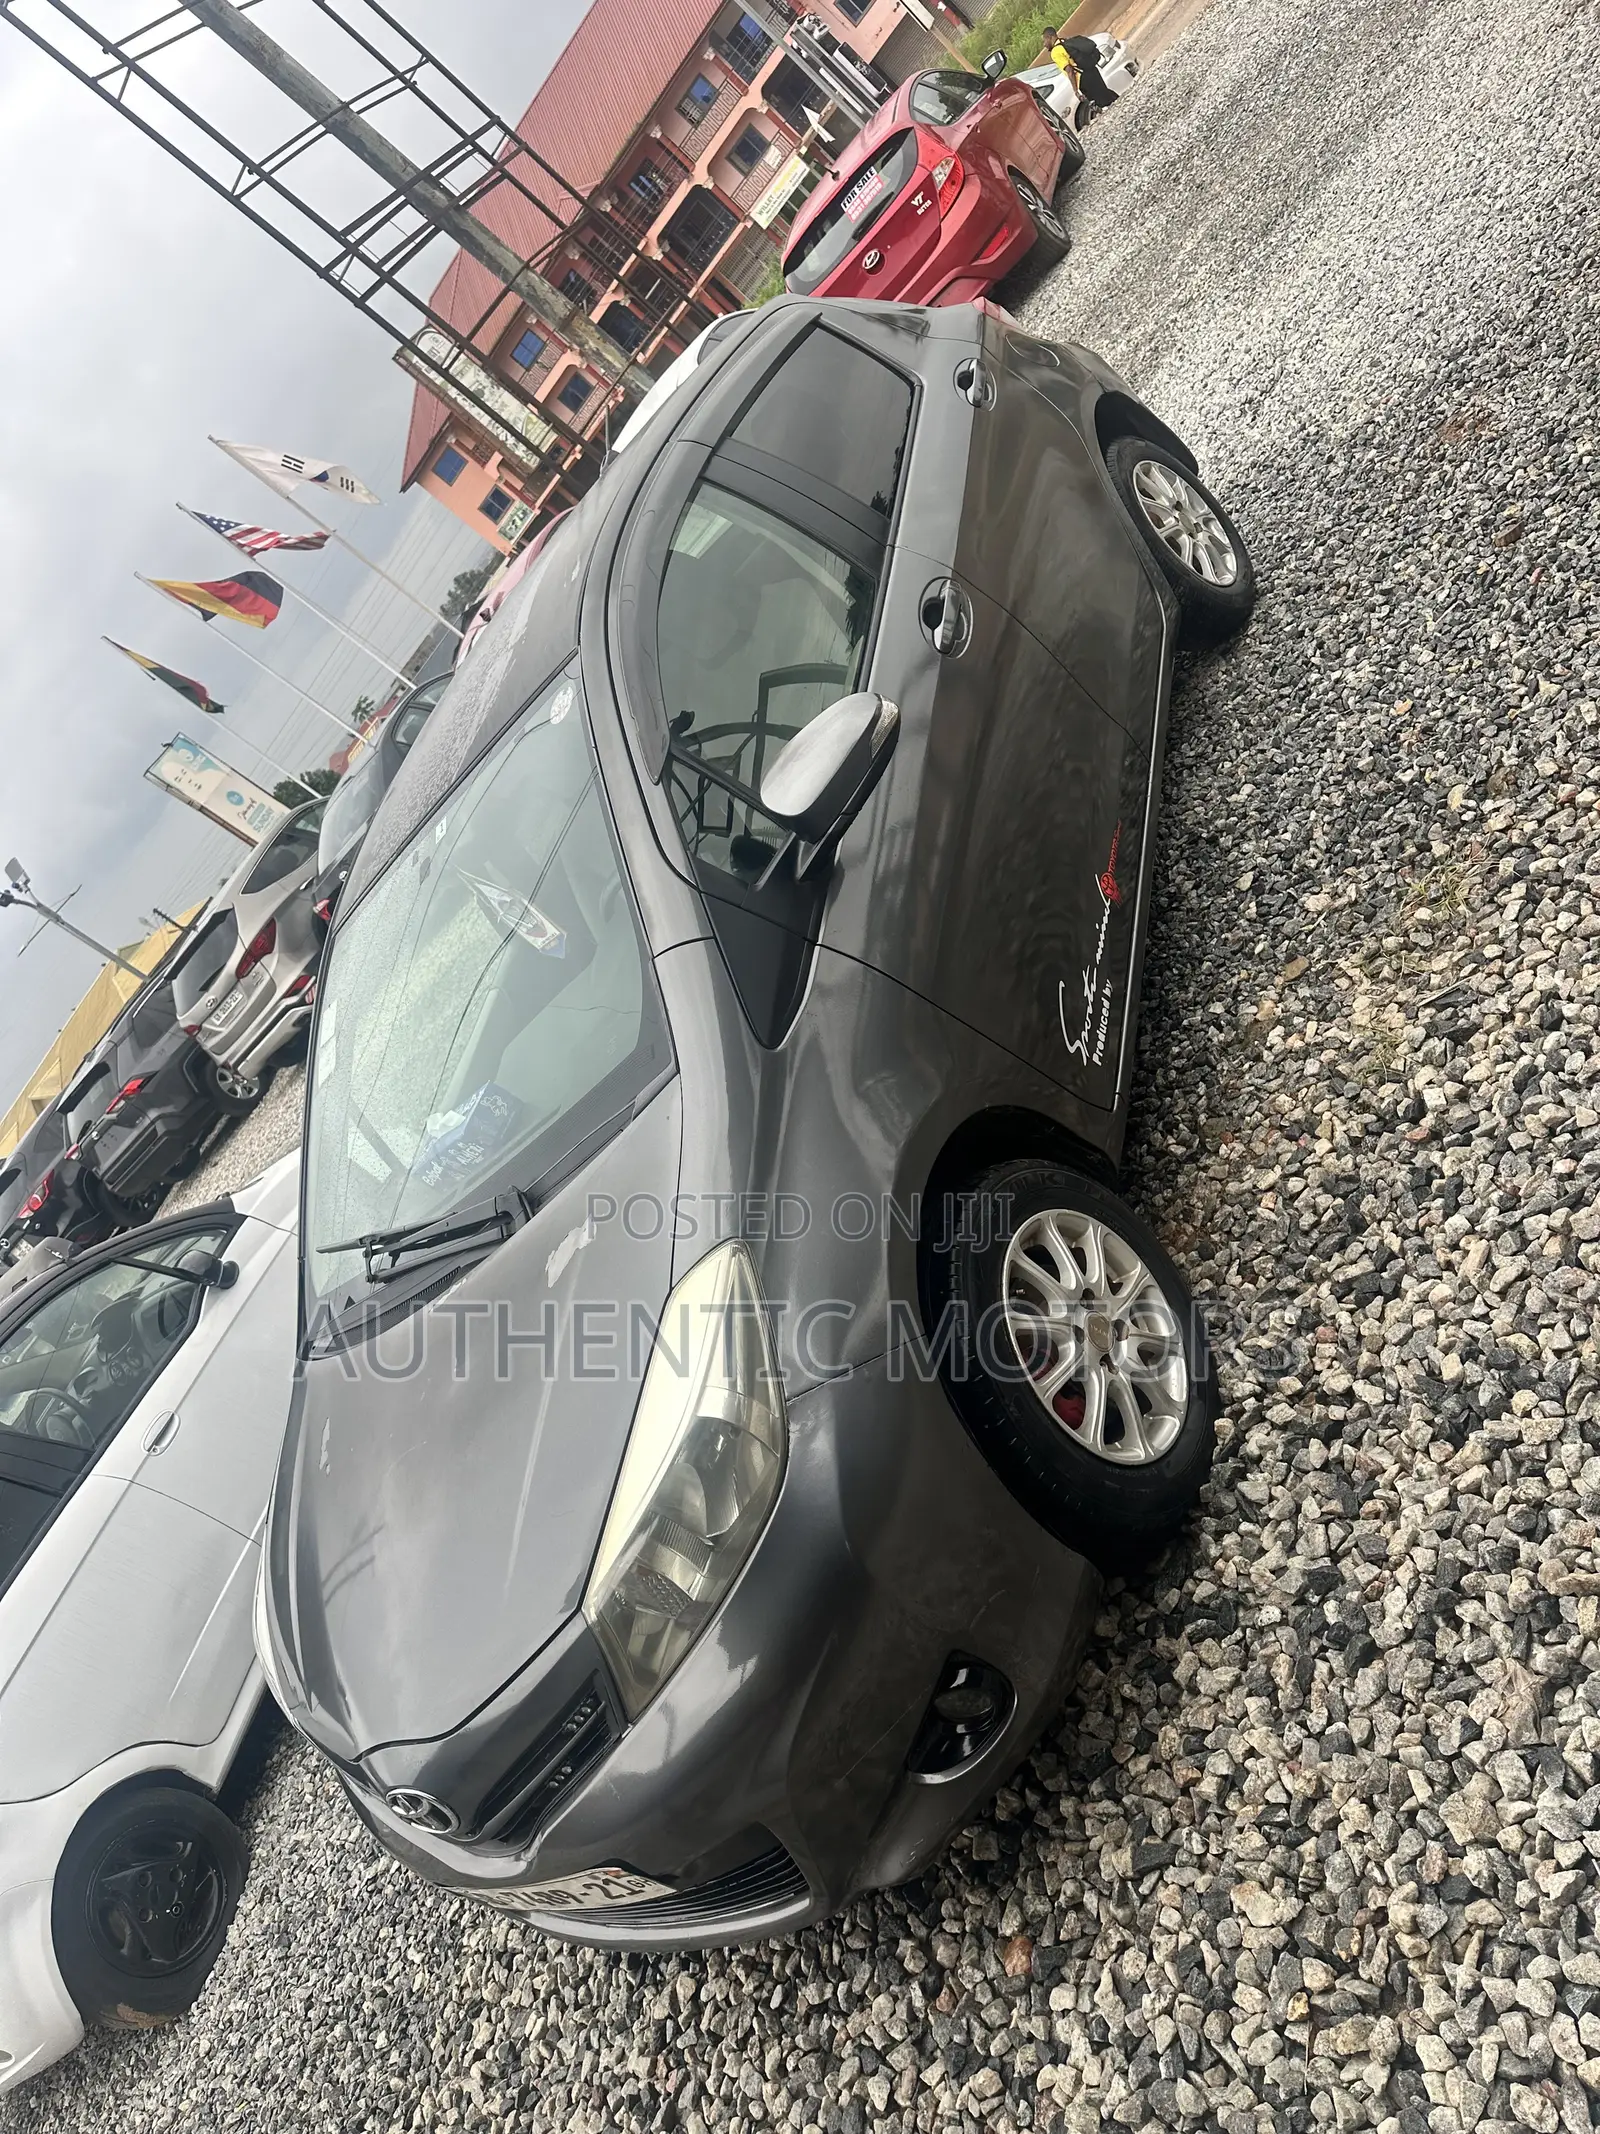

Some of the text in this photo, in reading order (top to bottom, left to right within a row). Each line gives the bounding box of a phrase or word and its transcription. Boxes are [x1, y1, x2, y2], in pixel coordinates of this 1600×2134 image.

[842, 189, 858, 209] FOR
[856, 168, 875, 191] SALE
[1092, 979, 1113, 1066] Produced by
